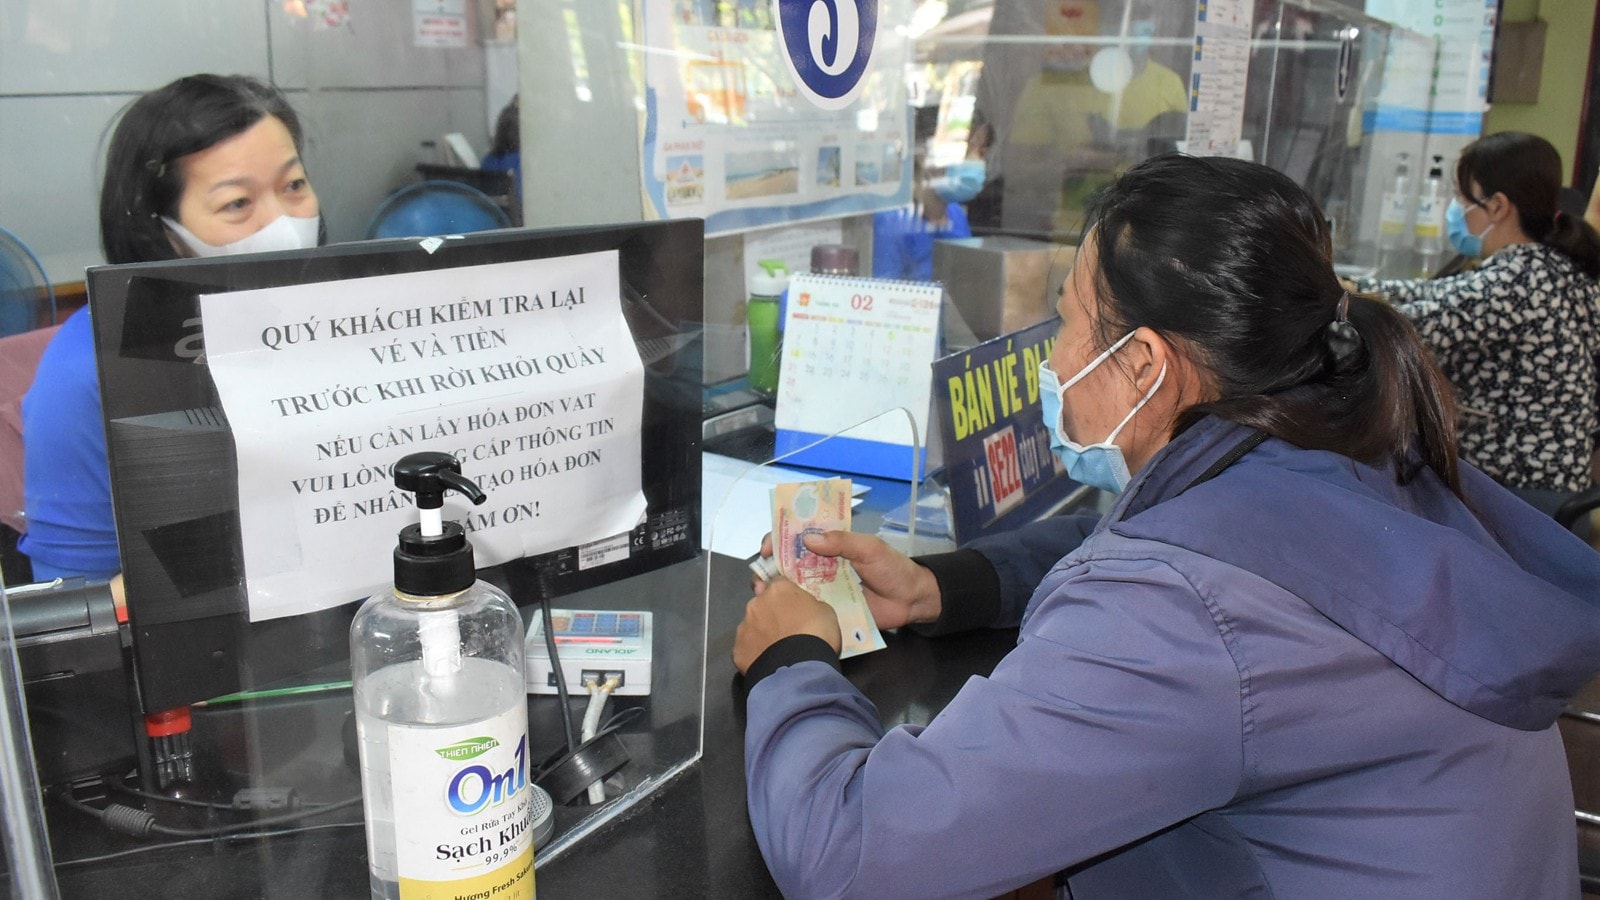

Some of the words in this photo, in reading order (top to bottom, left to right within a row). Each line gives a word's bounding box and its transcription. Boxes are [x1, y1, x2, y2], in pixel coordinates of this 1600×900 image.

[261, 315, 320, 350] QUÝ
[329, 307, 422, 338] KHÁCH
[430, 296, 493, 324] KIỂM
[499, 293, 544, 315] TRA
[551, 287, 586, 310] LẠI
[851, 294, 874, 311] 02
[369, 338, 406, 365] VÉ
[411, 333, 447, 359] VÀ
[451, 326, 508, 353] TIỀN
[271, 384, 373, 417] TRƯỚC
[374, 376, 427, 400] KHI
[429, 366, 478, 392] RỜI
[479, 355, 543, 383] KHỎI
[546, 345, 607, 374] QUẦY
[948, 354, 996, 441] BÁN
[993, 338, 1023, 418] VÉ
[316, 434, 363, 460] NẾU
[369, 426, 414, 450] CẦN
[420, 416, 461, 440] LẤY
[467, 408, 511, 432] HÓA
[515, 401, 555, 422] ĐƠN
[560, 393, 596, 413] VAT
[292, 474, 335, 495] VUI
[472, 437, 511, 461] CẤP
[515, 426, 582, 451] THÔNG
[587, 417, 615, 437] TIN
[313, 501, 347, 525] ĐỂ
[353, 490, 414, 518] NHÂN
[474, 469, 514, 492] TẠO
[520, 458, 560, 481] HÓA
[565, 449, 602, 471] ĐƠN
[452, 511, 497, 533] ÁM
[503, 501, 540, 524] ƠN!
[448, 733, 526, 813] On1
[460, 825, 478, 836] Gel
[481, 820, 500, 831] Rửa
[502, 811, 515, 822] Tay
[436, 837, 491, 863] Sạch
[485, 845, 518, 866] 99,9%
[492, 878, 515, 895] Fresh
